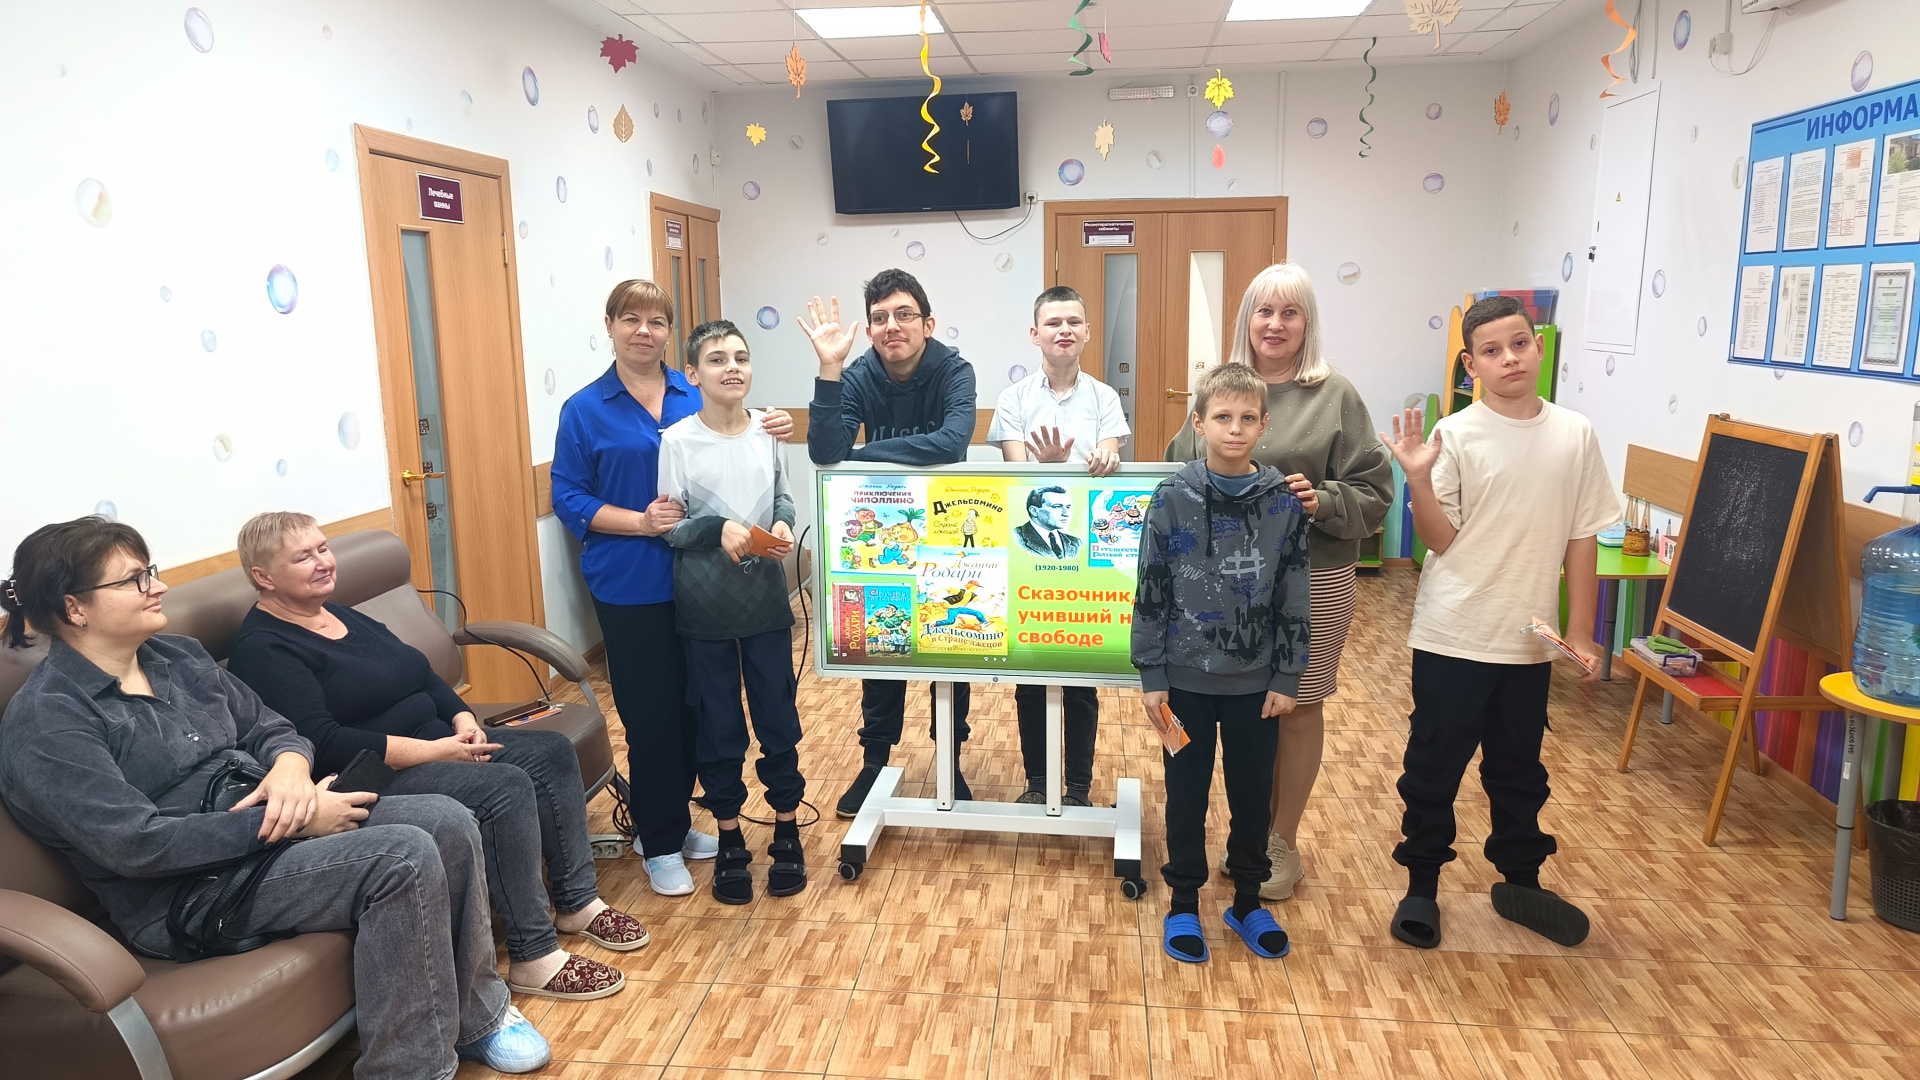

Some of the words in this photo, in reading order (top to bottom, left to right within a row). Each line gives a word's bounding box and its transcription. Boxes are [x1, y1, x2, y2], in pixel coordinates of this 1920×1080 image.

[428, 187, 454, 200] Лечебные
[433, 200, 451, 210] ванны
[1212, 518, 1242, 534] BEST
[921, 562, 982, 581] Родари
[1017, 608, 1112, 624] учивший
[921, 623, 1004, 641] Джельсомино
[1017, 629, 1104, 647] свободе
[937, 634, 968, 645] Стране
[969, 640, 1003, 649] лжецов
